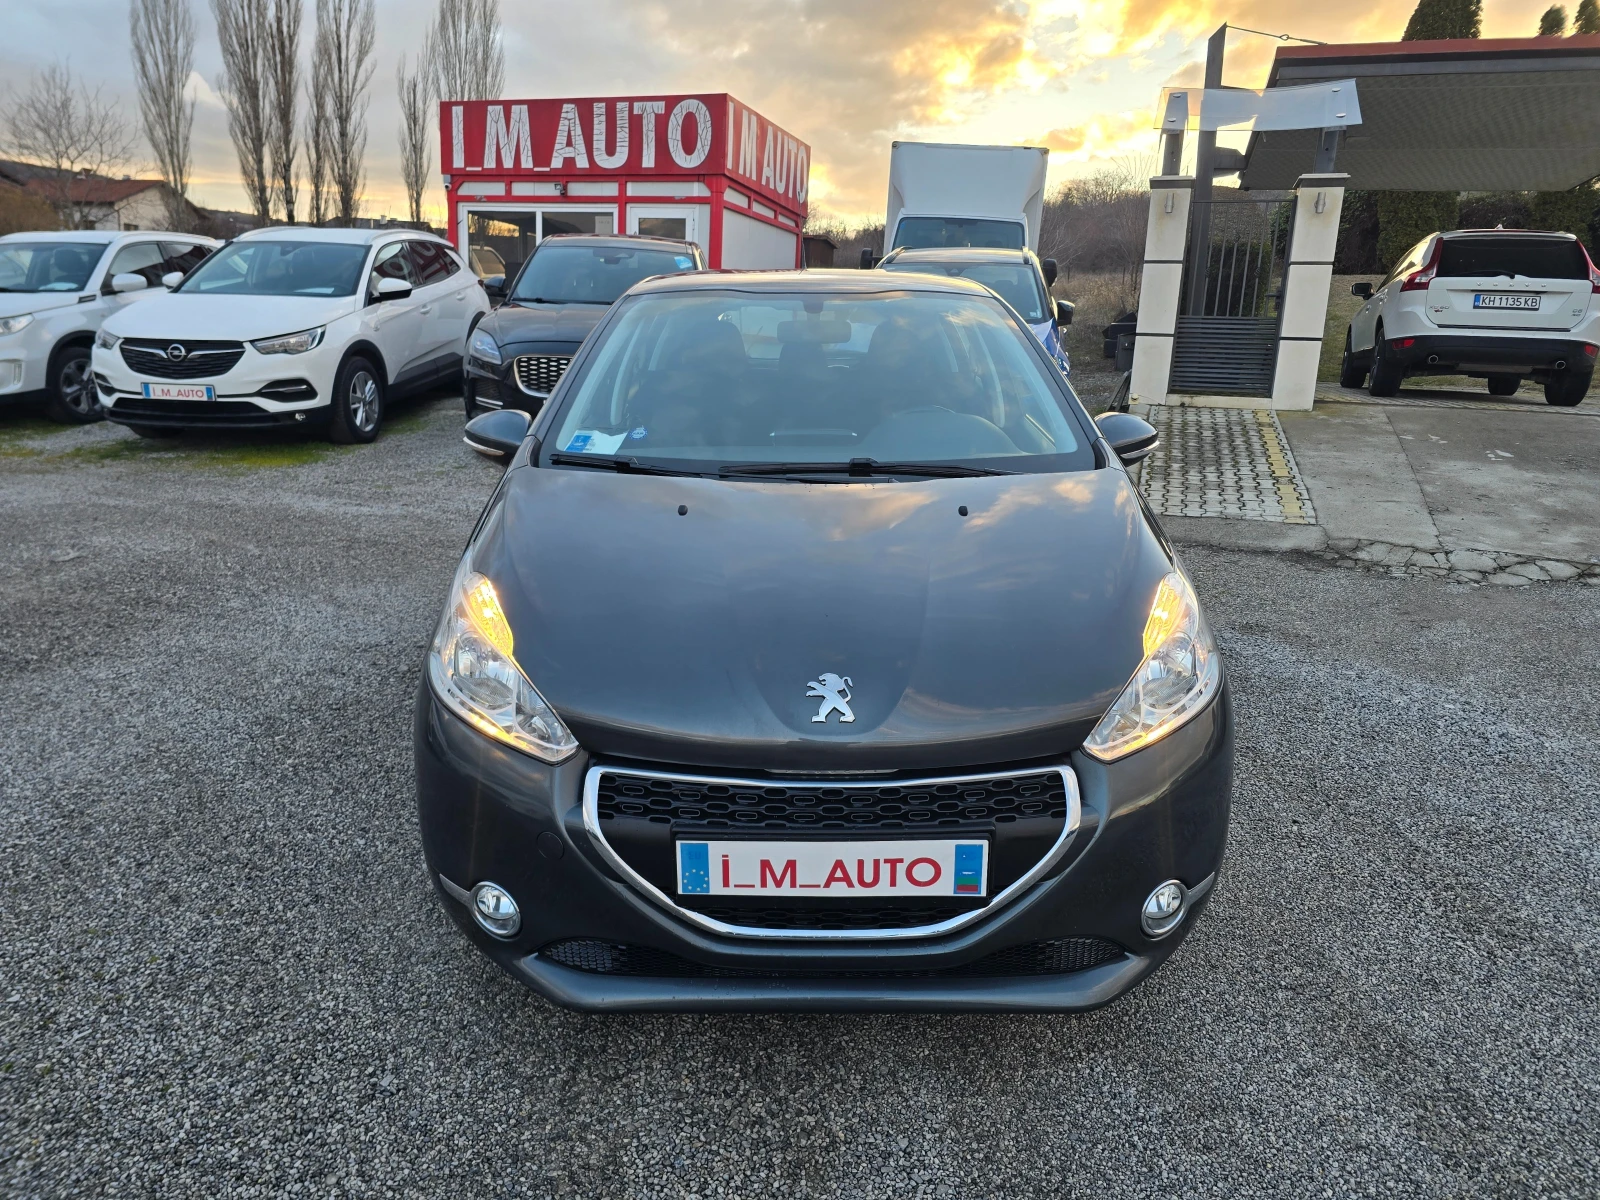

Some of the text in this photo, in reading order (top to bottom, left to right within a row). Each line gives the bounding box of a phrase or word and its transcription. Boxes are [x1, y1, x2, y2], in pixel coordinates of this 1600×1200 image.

[451, 98, 712, 171] I_M_AUTO
[738, 108, 757, 182] M
[761, 125, 808, 204] AUTO
[1480, 296, 1496, 306] KH
[1498, 296, 1522, 307] 1135
[1523, 297, 1538, 308] KB
